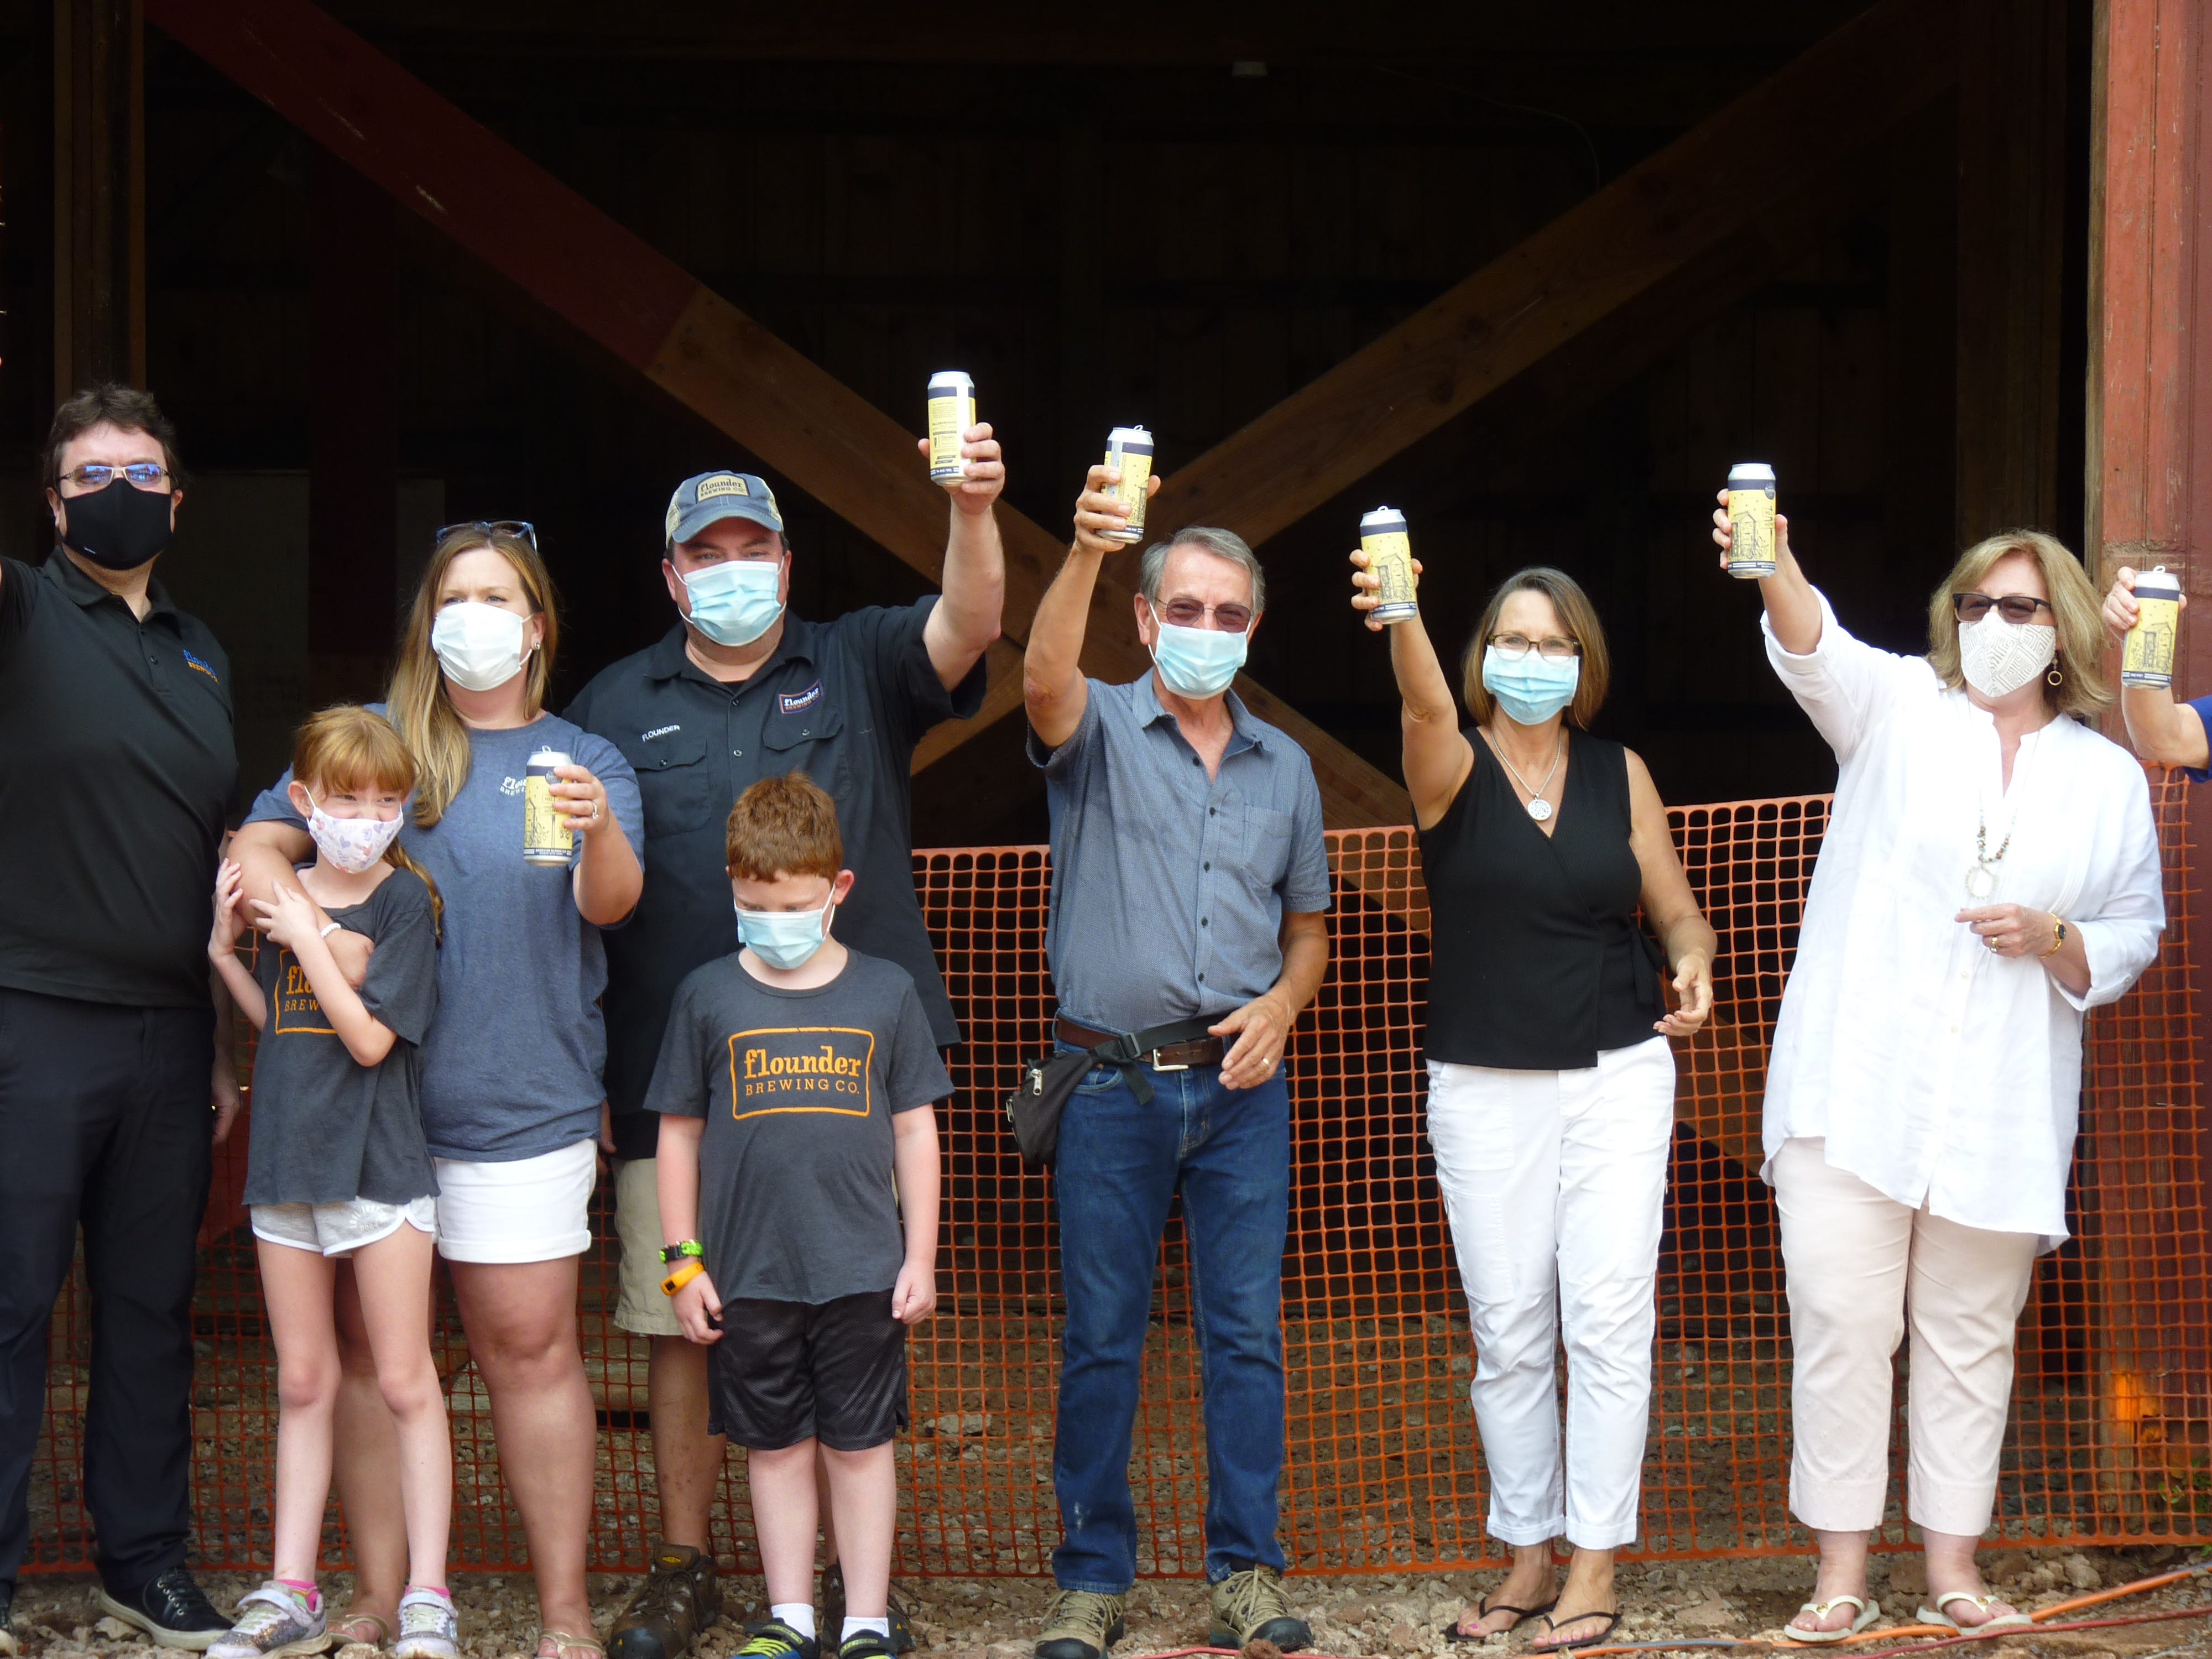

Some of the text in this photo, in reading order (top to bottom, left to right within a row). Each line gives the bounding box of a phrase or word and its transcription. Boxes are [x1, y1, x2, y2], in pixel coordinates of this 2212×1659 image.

[700, 478, 743, 493] flounder
[700, 487, 731, 497] BREWING
[784, 687, 819, 706] flounder
[641, 724, 681, 742] FLOUNDER
[502, 776, 526, 790] flou
[286, 966, 313, 995] flo
[284, 999, 319, 1012] BREW
[744, 1045, 862, 1078] flounder
[744, 1078, 860, 1097] BREWING CO.
